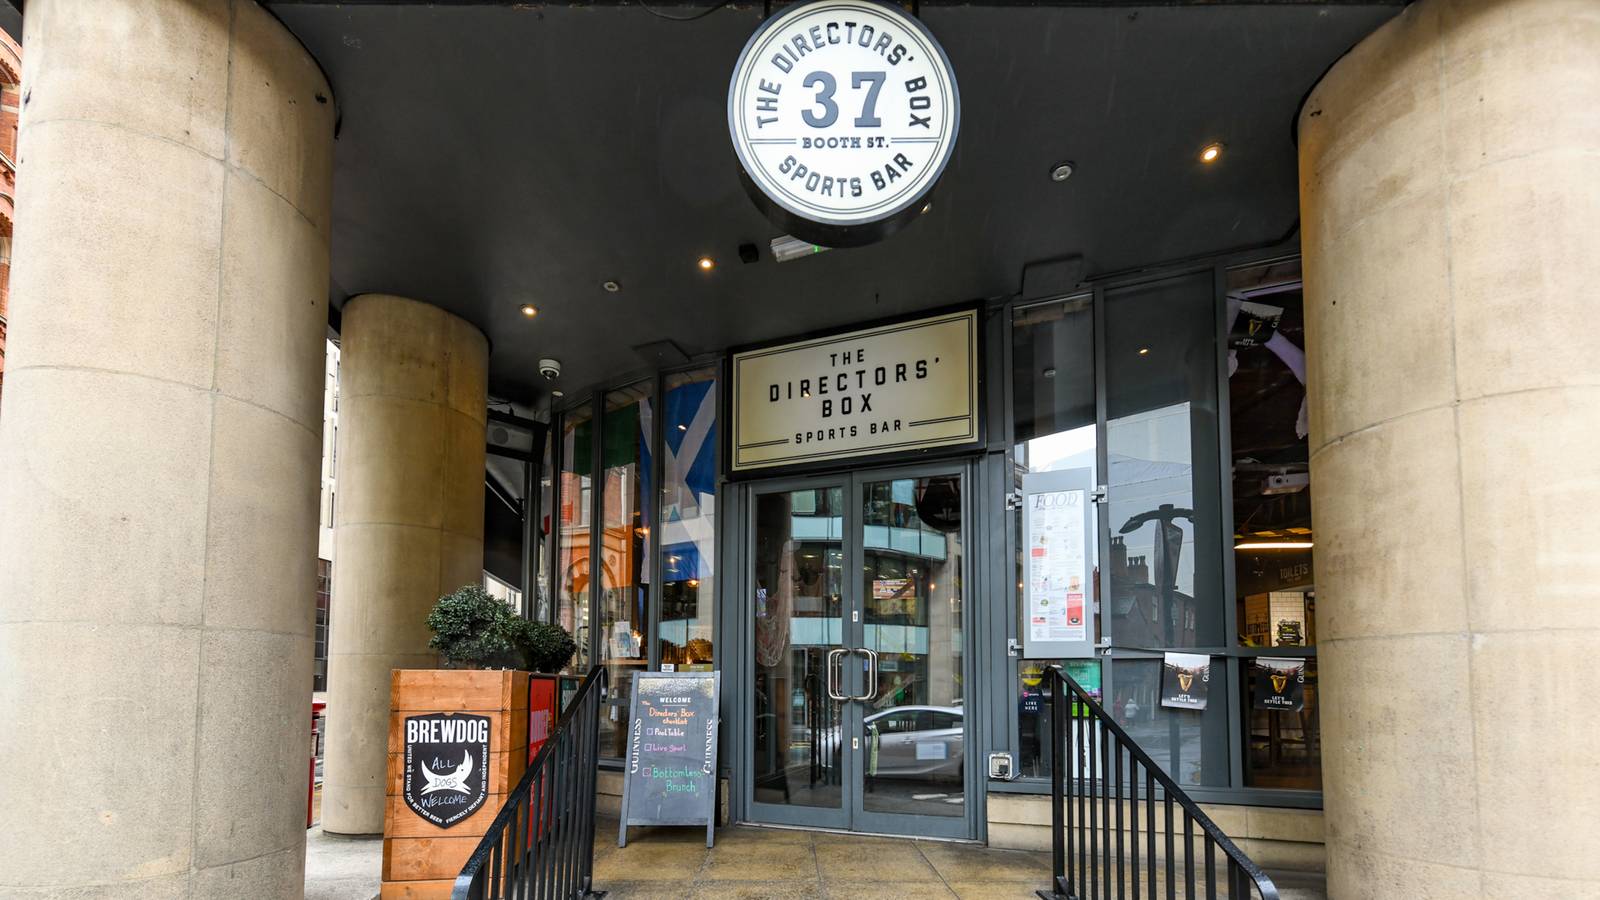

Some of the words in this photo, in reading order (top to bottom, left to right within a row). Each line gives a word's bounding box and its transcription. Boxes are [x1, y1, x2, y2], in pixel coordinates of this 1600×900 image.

[756, 78, 782, 128] THE
[771, 21, 915, 74] DIRECTORS'
[905, 76, 931, 129] BOX
[801, 70, 887, 128] 37
[802, 137, 861, 149] BOOTH
[867, 137, 889, 148] ST.
[778, 155, 863, 198] SPORTS
[870, 153, 914, 191] BAR
[830, 349, 865, 367] THE
[769, 357, 940, 402] DIRECTORS'
[822, 393, 872, 418] BOX
[795, 426, 858, 444] SPORTS
[870, 420, 902, 434] BAR
[1034, 491, 1079, 508] FOOD
[1280, 563, 1308, 579] TOILETS
[681, 708, 696, 718] Box
[407, 719, 489, 743] BREWDOG
[655, 728, 668, 737] Pool
[668, 728, 685, 737] Table
[631, 718, 642, 774] GUINNESS
[653, 743, 668, 752] Live
[703, 719, 713, 774] GUINNESS
[431, 757, 456, 770] ALL
[432, 778, 458, 788] DOGS
[666, 780, 696, 792] Brunch
[421, 794, 467, 808] WELCOME
